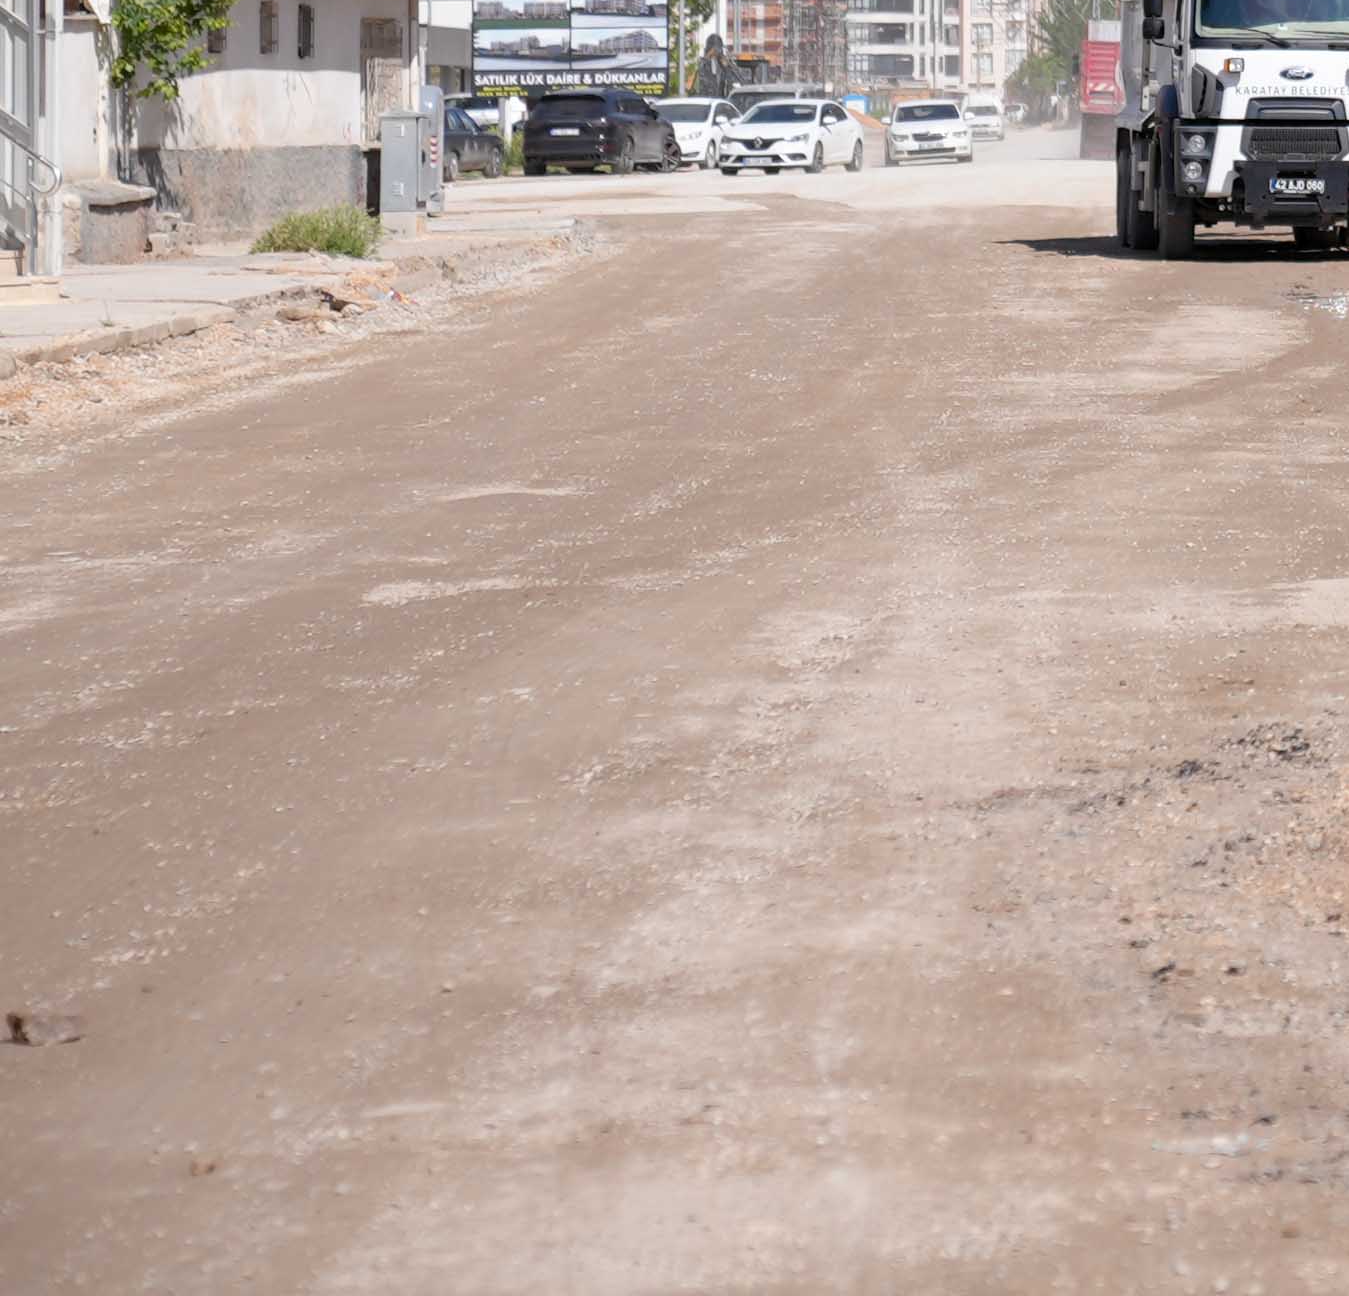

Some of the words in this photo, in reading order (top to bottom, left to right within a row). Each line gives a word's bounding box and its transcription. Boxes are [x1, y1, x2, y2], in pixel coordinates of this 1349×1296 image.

[474, 74, 518, 85] SATILIK
[547, 72, 579, 85] DAİRE
[595, 71, 666, 85] DÜKKANLAR
[1235, 86, 1287, 96] KARATAY
